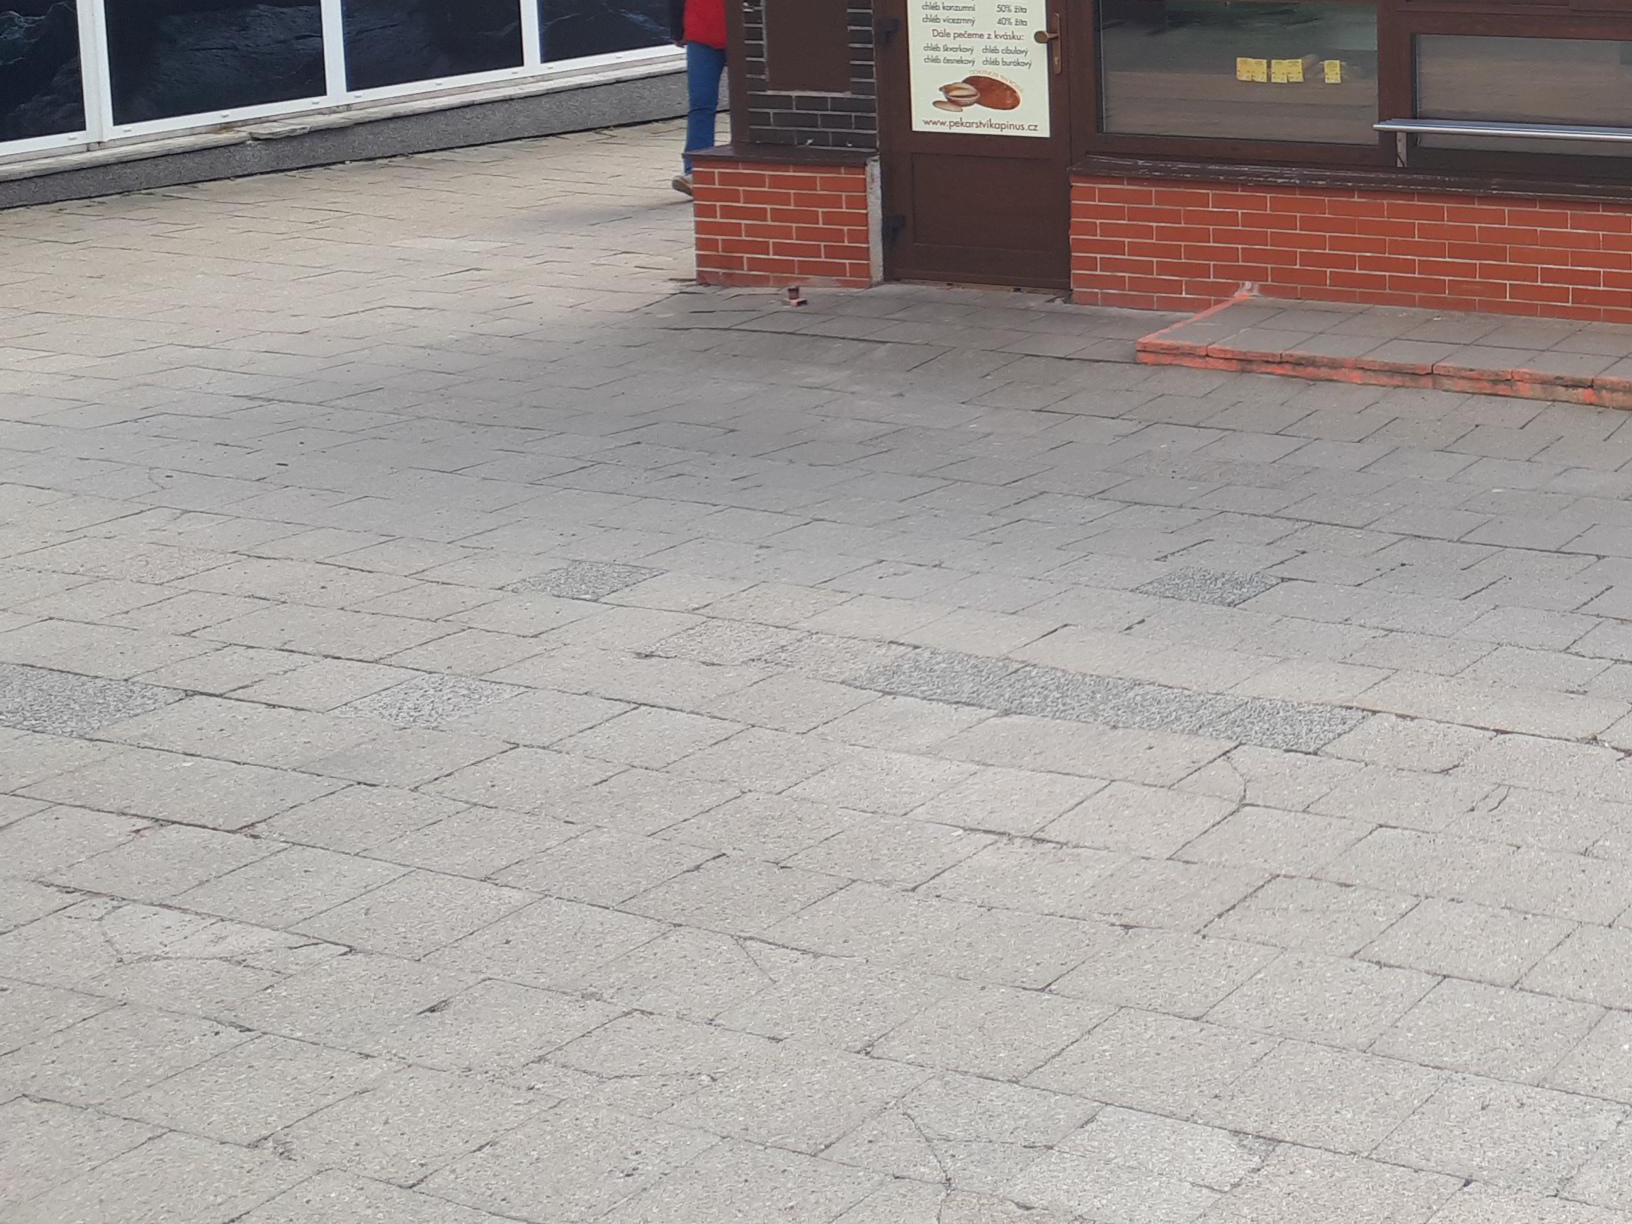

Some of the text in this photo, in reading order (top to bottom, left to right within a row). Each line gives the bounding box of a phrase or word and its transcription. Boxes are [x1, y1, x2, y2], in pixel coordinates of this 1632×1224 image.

[932, 28, 951, 38] Dále
[953, 31, 985, 40] pečeme
[922, 117, 1039, 132] www.pekarstvikapinus.cz
